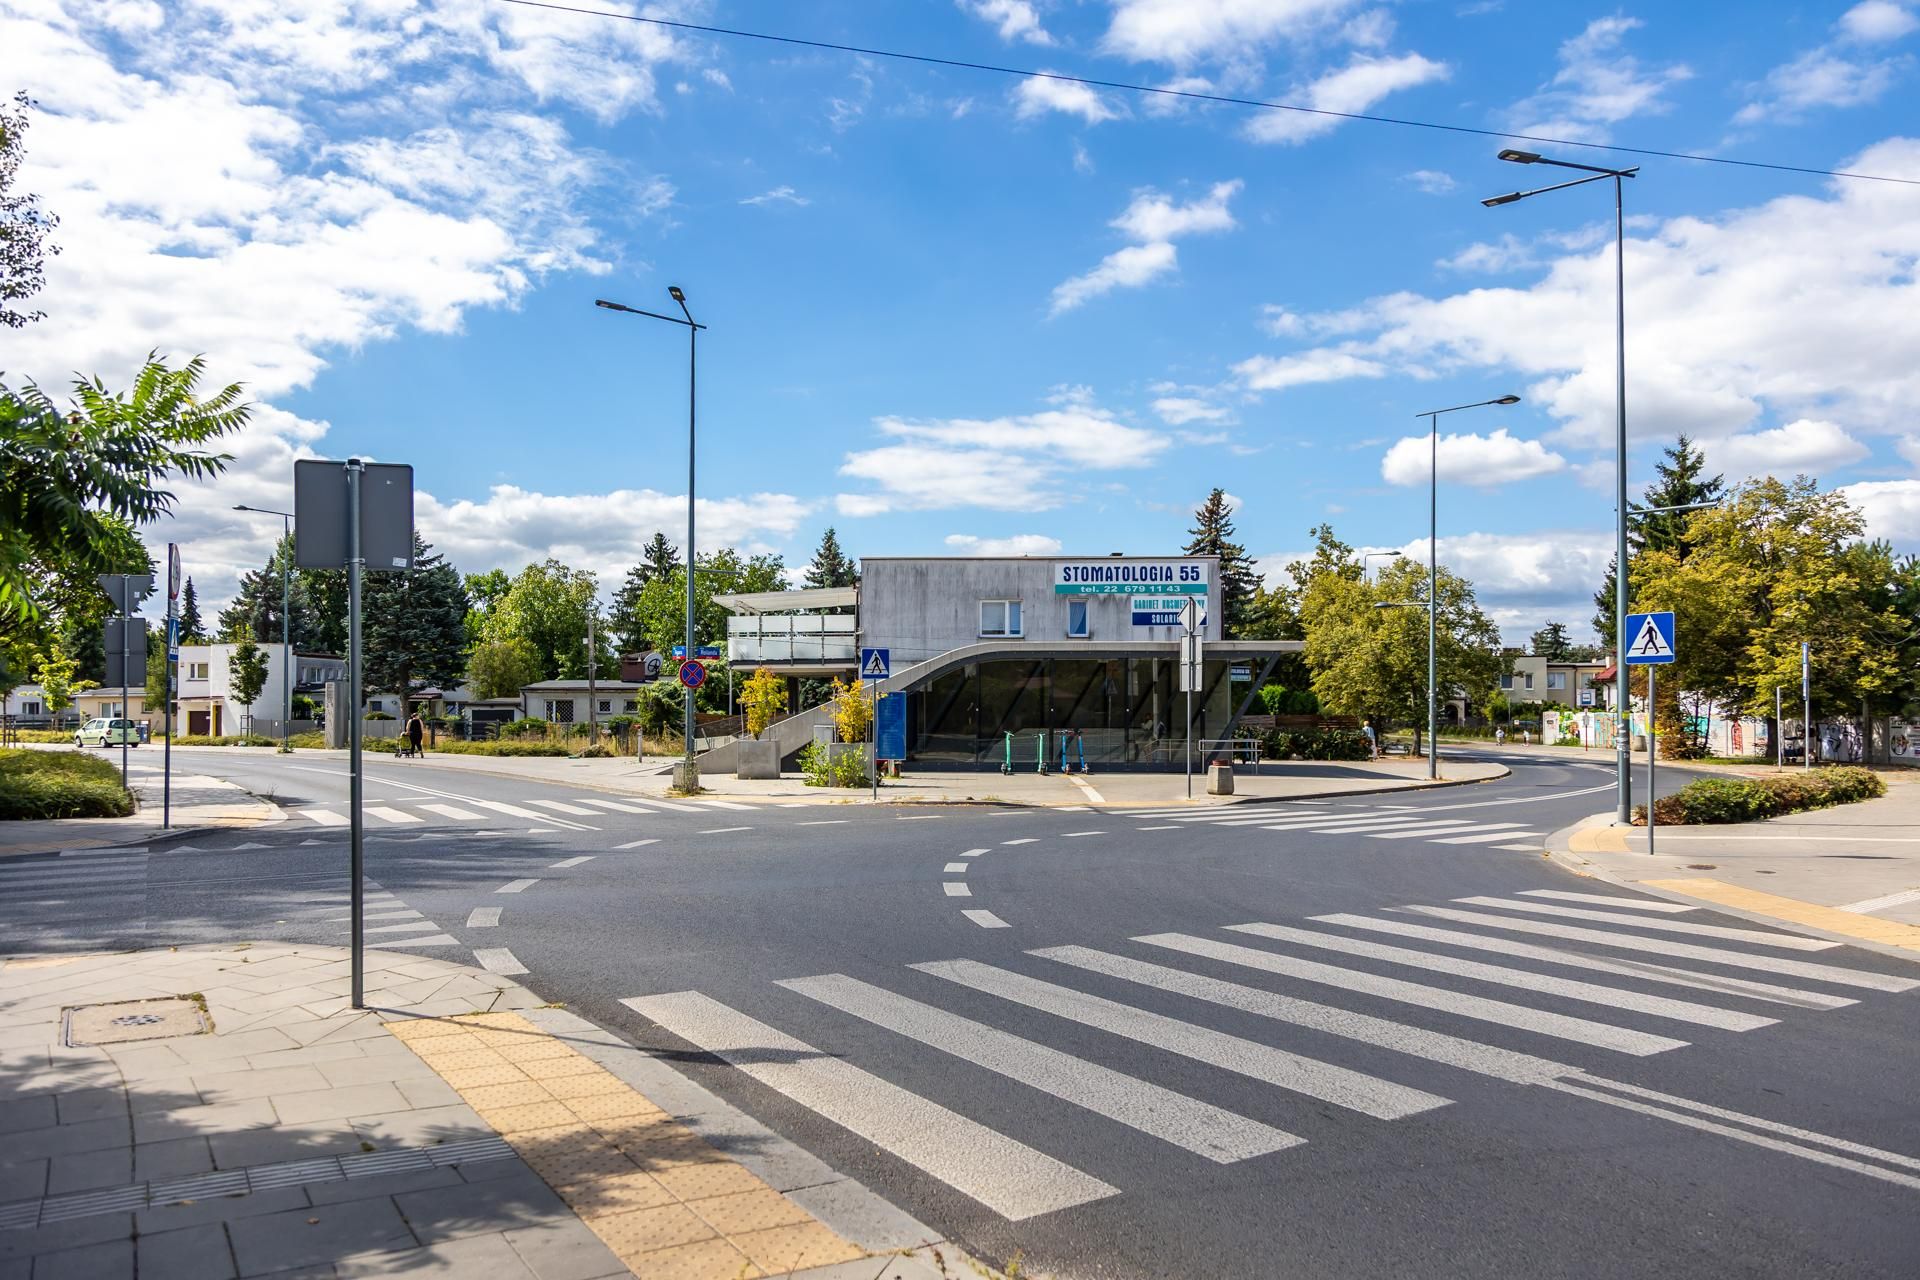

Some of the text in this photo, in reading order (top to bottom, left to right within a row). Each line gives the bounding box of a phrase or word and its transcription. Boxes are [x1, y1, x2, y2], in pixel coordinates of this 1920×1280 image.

[1063, 566, 1200, 582] STOMATOLOGIA 55
[1080, 585, 1181, 593] tel. 22 679 11 43
